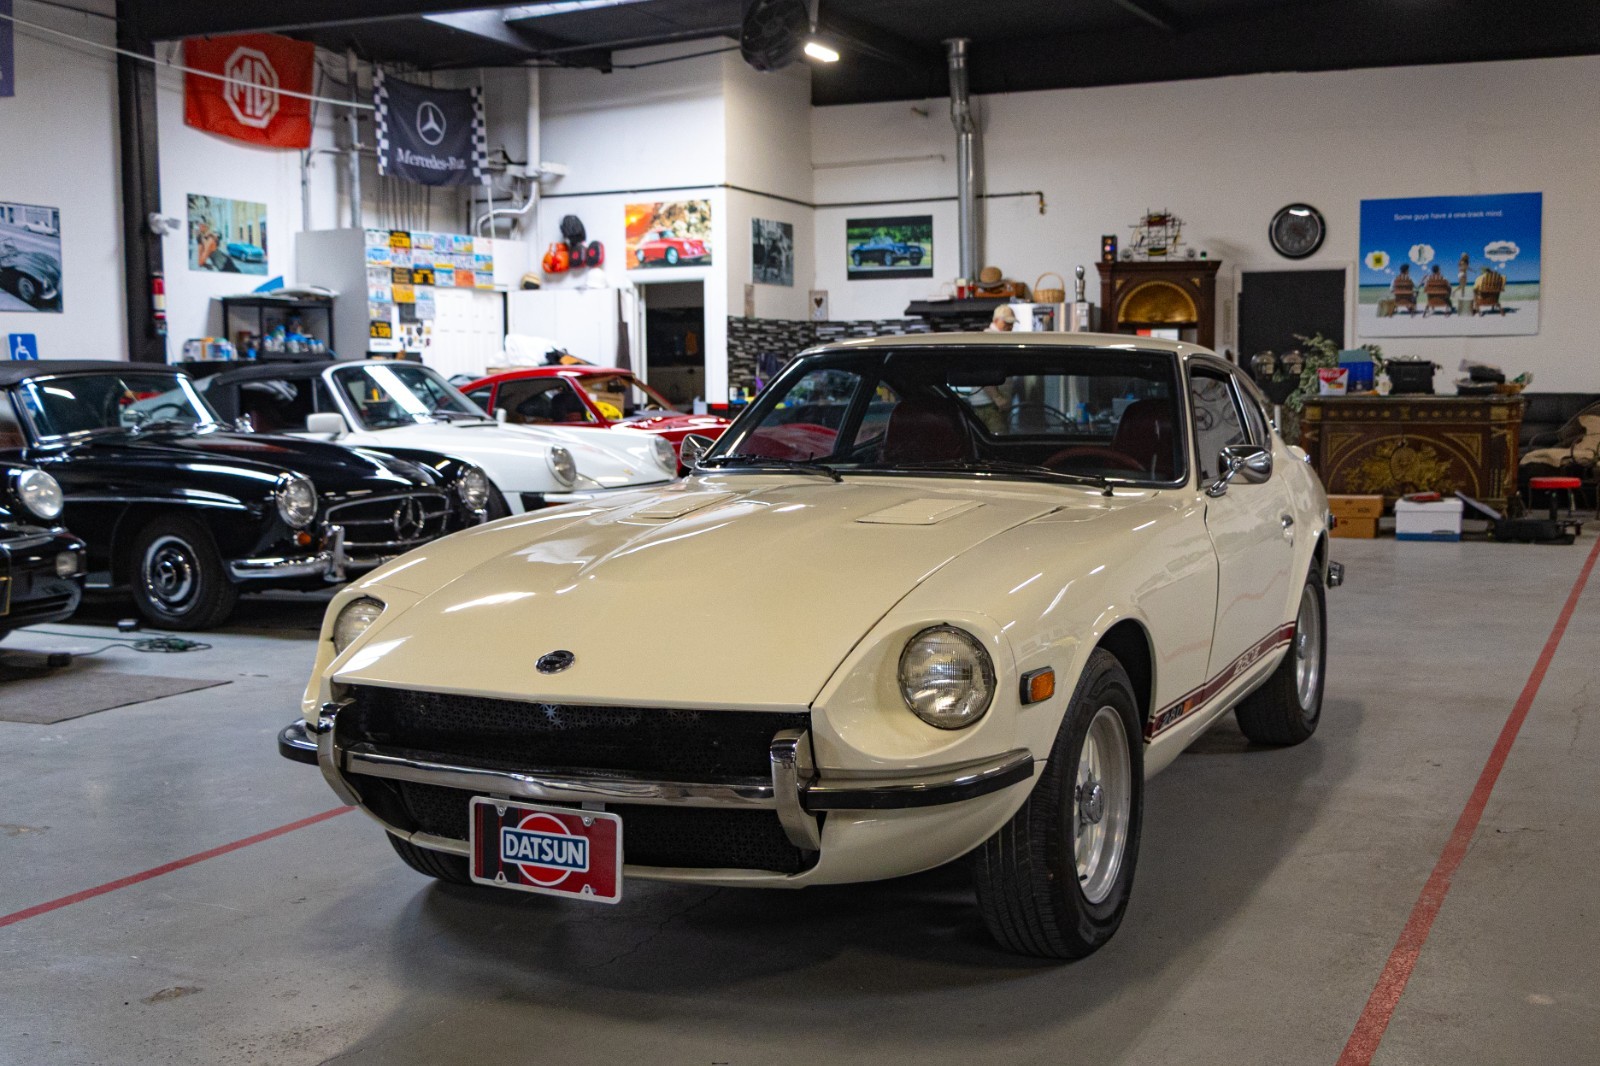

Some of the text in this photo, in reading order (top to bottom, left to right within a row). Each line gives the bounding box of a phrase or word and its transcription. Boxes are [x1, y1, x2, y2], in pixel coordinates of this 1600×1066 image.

[232, 59, 273, 117] MG
[396, 147, 467, 171] Mercedes-Bz
[1394, 213, 1412, 221] Some
[1414, 213, 1429, 221] guys
[1431, 211, 1446, 219] have
[505, 833, 584, 866] DATSUN
